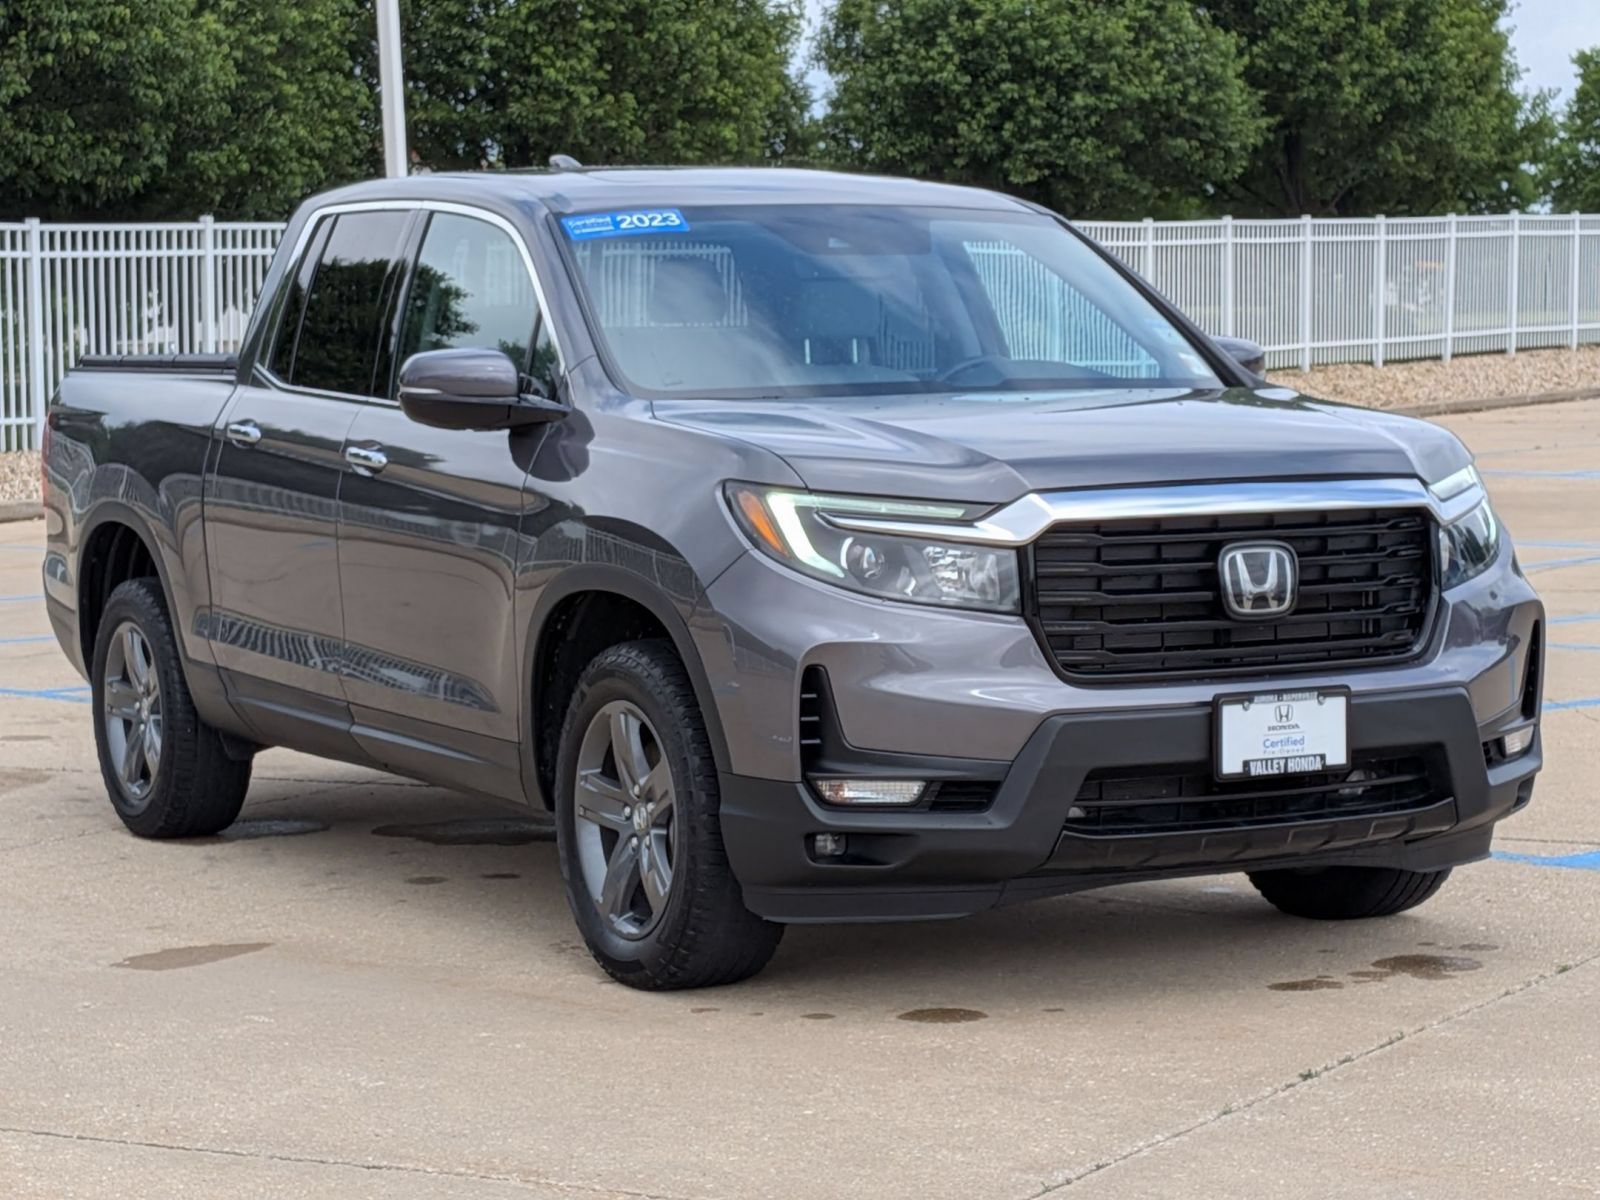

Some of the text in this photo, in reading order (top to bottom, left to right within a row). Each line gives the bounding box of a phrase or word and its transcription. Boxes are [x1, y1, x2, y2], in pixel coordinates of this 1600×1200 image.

[616, 213, 681, 229] 2023
[1267, 723, 1301, 732] HONDA
[1263, 736, 1305, 749] Certified
[1249, 755, 1322, 776] VALLEY HONDA
